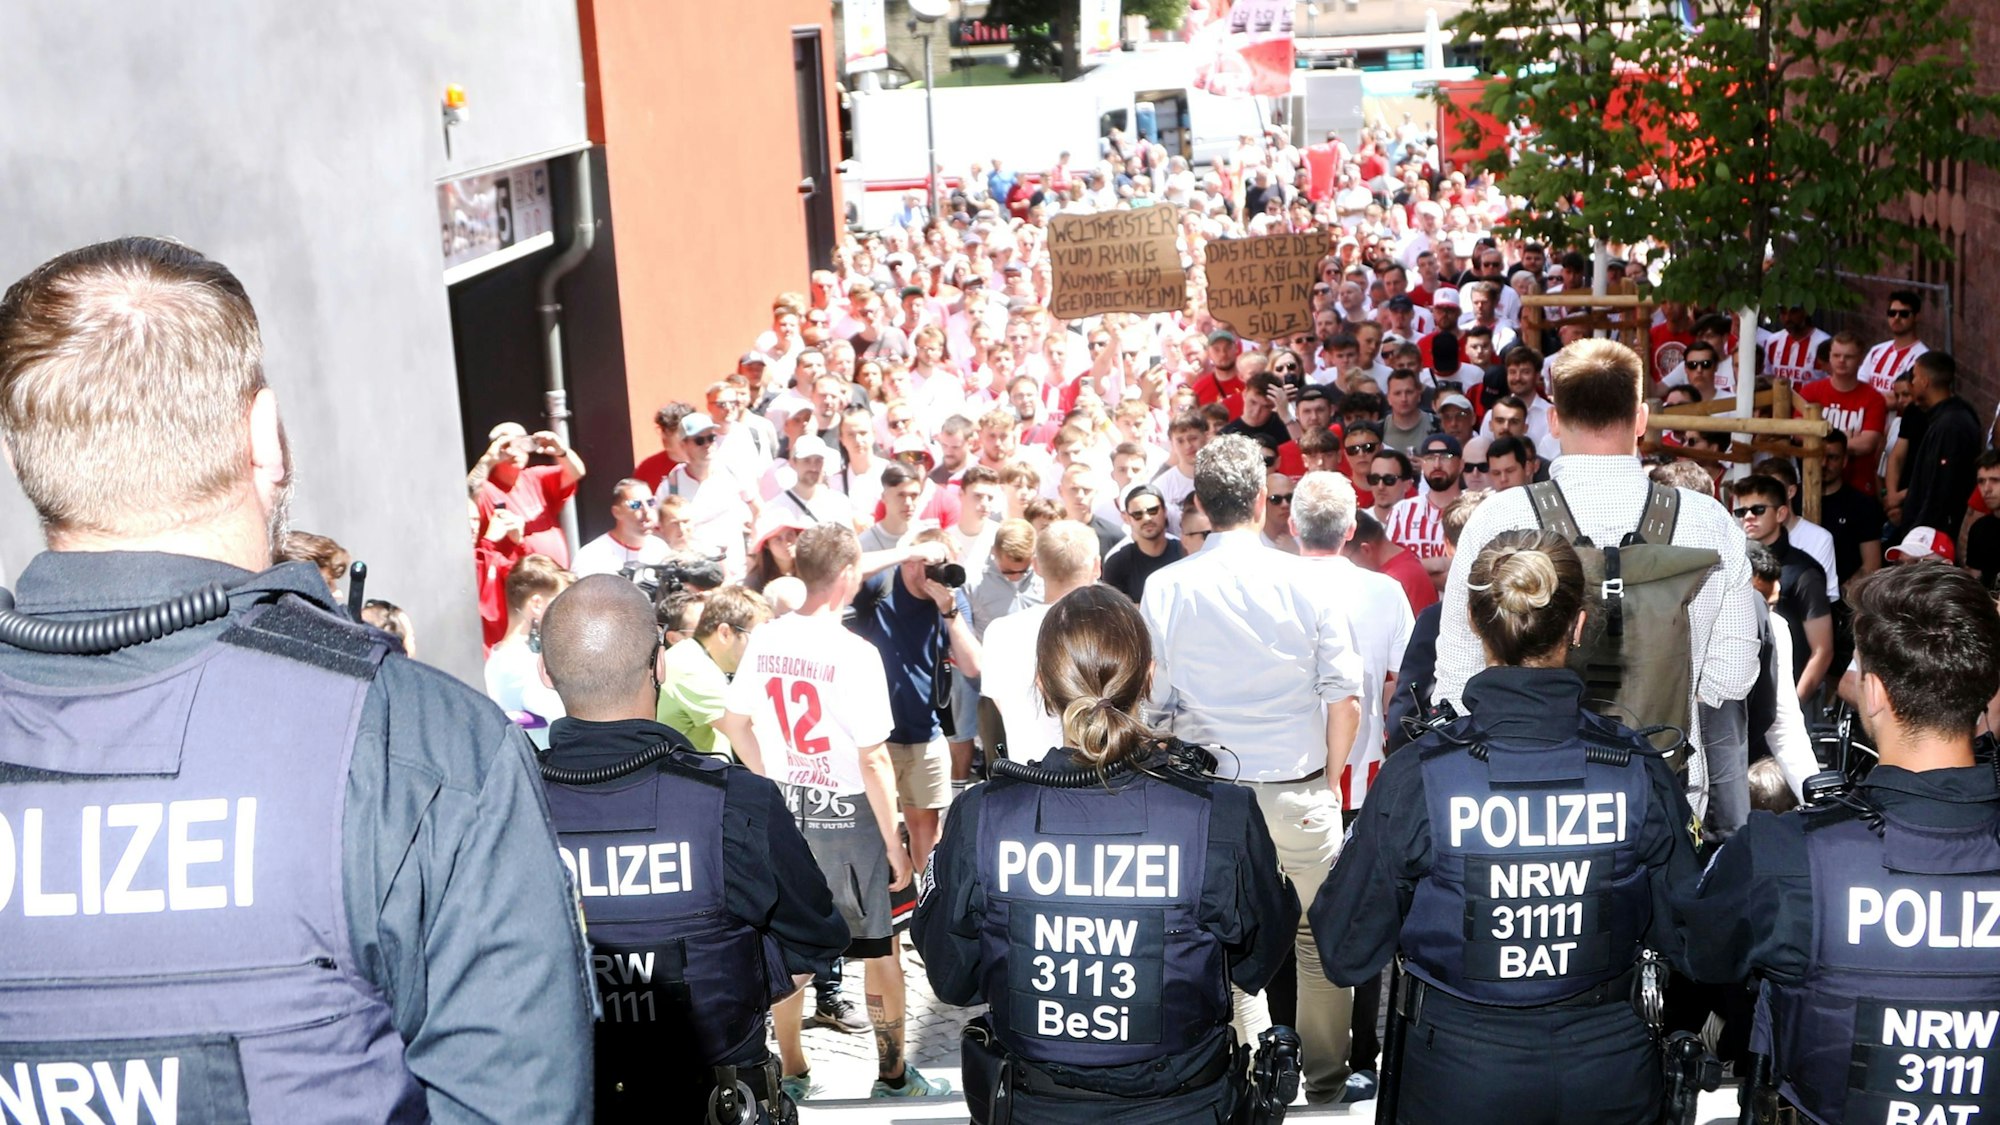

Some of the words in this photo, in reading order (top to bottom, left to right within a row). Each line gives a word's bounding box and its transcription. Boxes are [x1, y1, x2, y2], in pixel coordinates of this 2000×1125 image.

[1051, 207, 1176, 243] WELTMEISTER
[1098, 240, 1158, 266] RHING
[1208, 242, 1239, 263] DAS
[1243, 237, 1289, 259] HERZ
[1294, 234, 1327, 256] DES
[1059, 270, 1119, 292] KUMME
[1264, 260, 1310, 282] KÖLN
[1210, 285, 1284, 310] SCHLÄGT
[1291, 283, 1310, 301] IN
[1407, 542, 1448, 559] REW
[765, 677, 831, 755] 12
[807, 787, 856, 817] 96
[1450, 791, 1627, 848] POLIZEI
[0, 797, 257, 917] LIZEI
[998, 840, 1180, 898] POLIZEI
[1490, 860, 1591, 899] NRW
[1034, 913, 1139, 957] NRW
[1491, 901, 1583, 940] 31111
[1847, 887, 2000, 948] POLIZ
[593, 951, 655, 986] RW
[1031, 955, 1137, 1000] 3113
[1499, 942, 1577, 979] BAT
[1037, 999, 1129, 1041] BeSi
[1882, 1007, 2000, 1049] NRW
[1895, 1053, 1985, 1095] 3111
[1885, 1100, 1980, 1125] BAT
